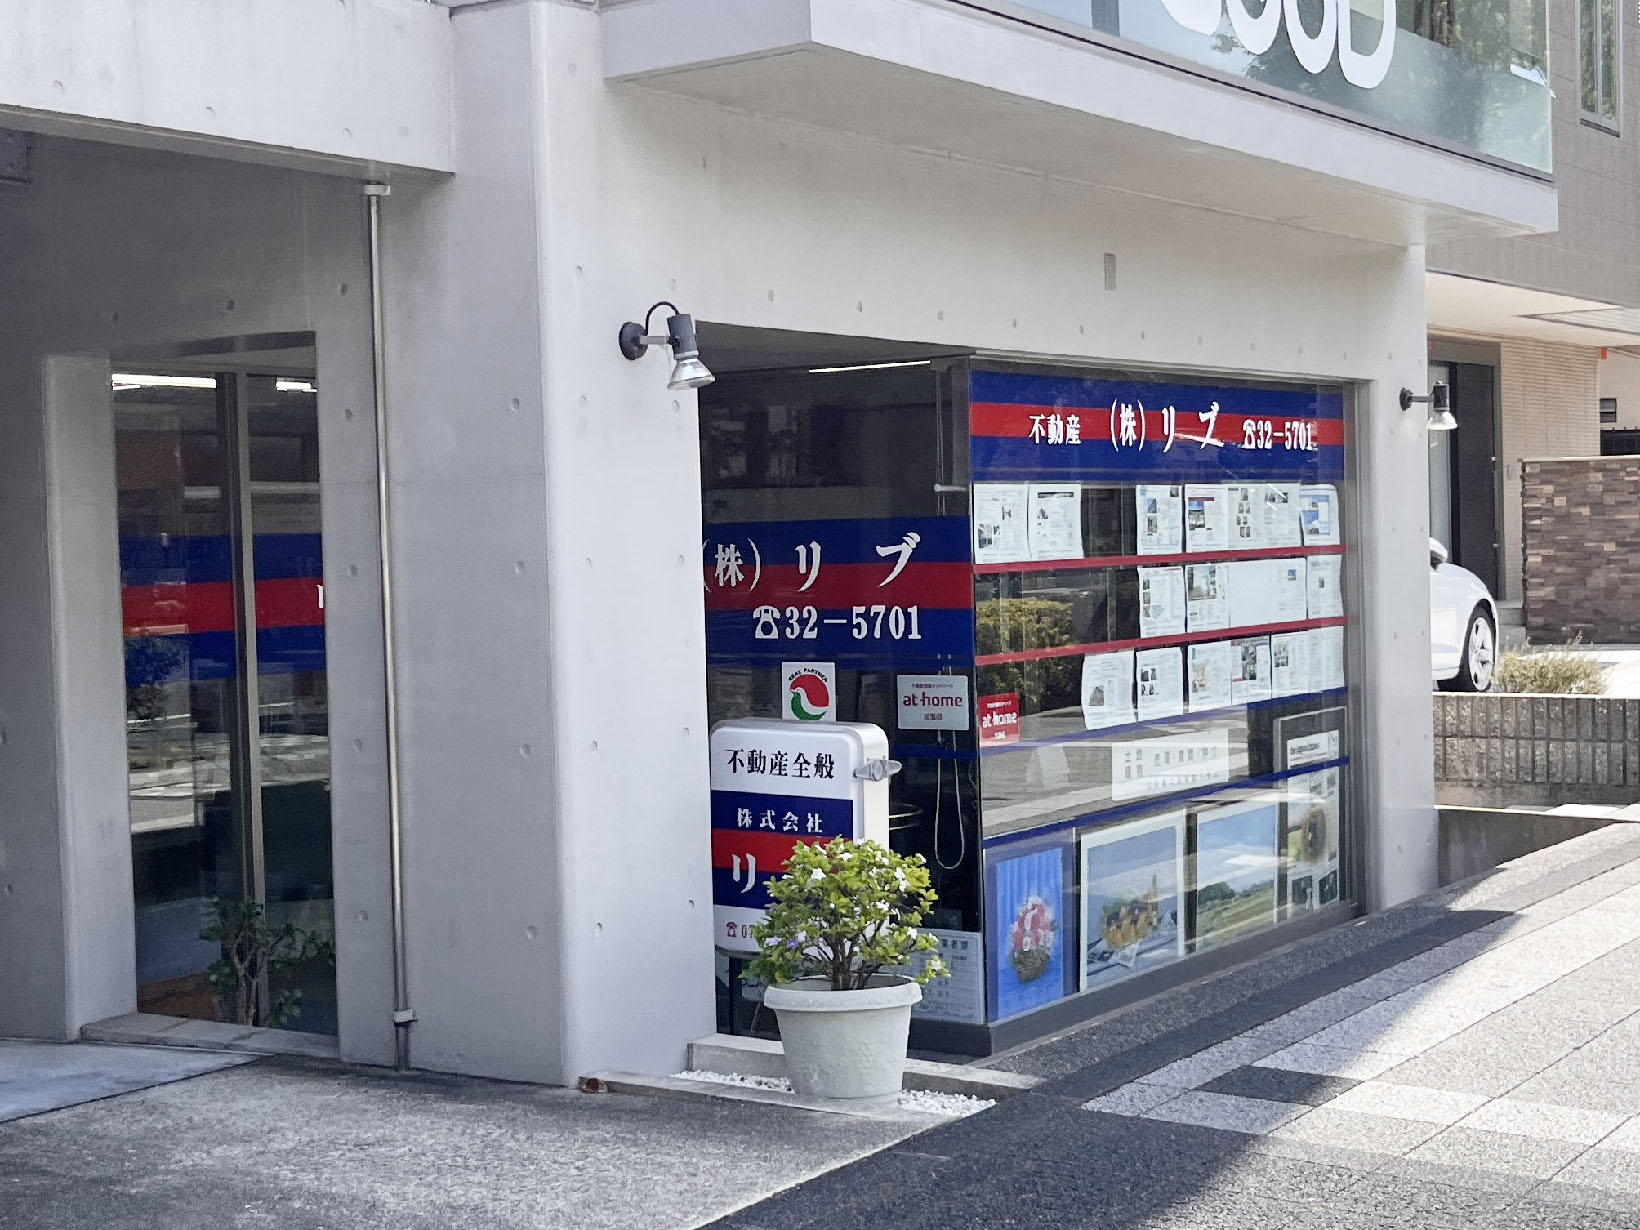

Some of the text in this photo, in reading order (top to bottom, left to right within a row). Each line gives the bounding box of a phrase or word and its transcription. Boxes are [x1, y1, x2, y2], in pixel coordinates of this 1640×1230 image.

[1028, 413, 1082, 445] 不動産
[725, 749, 835, 779] 不動産全般
[737, 807, 823, 833] 株式会社
[731, 853, 756, 894] リ
